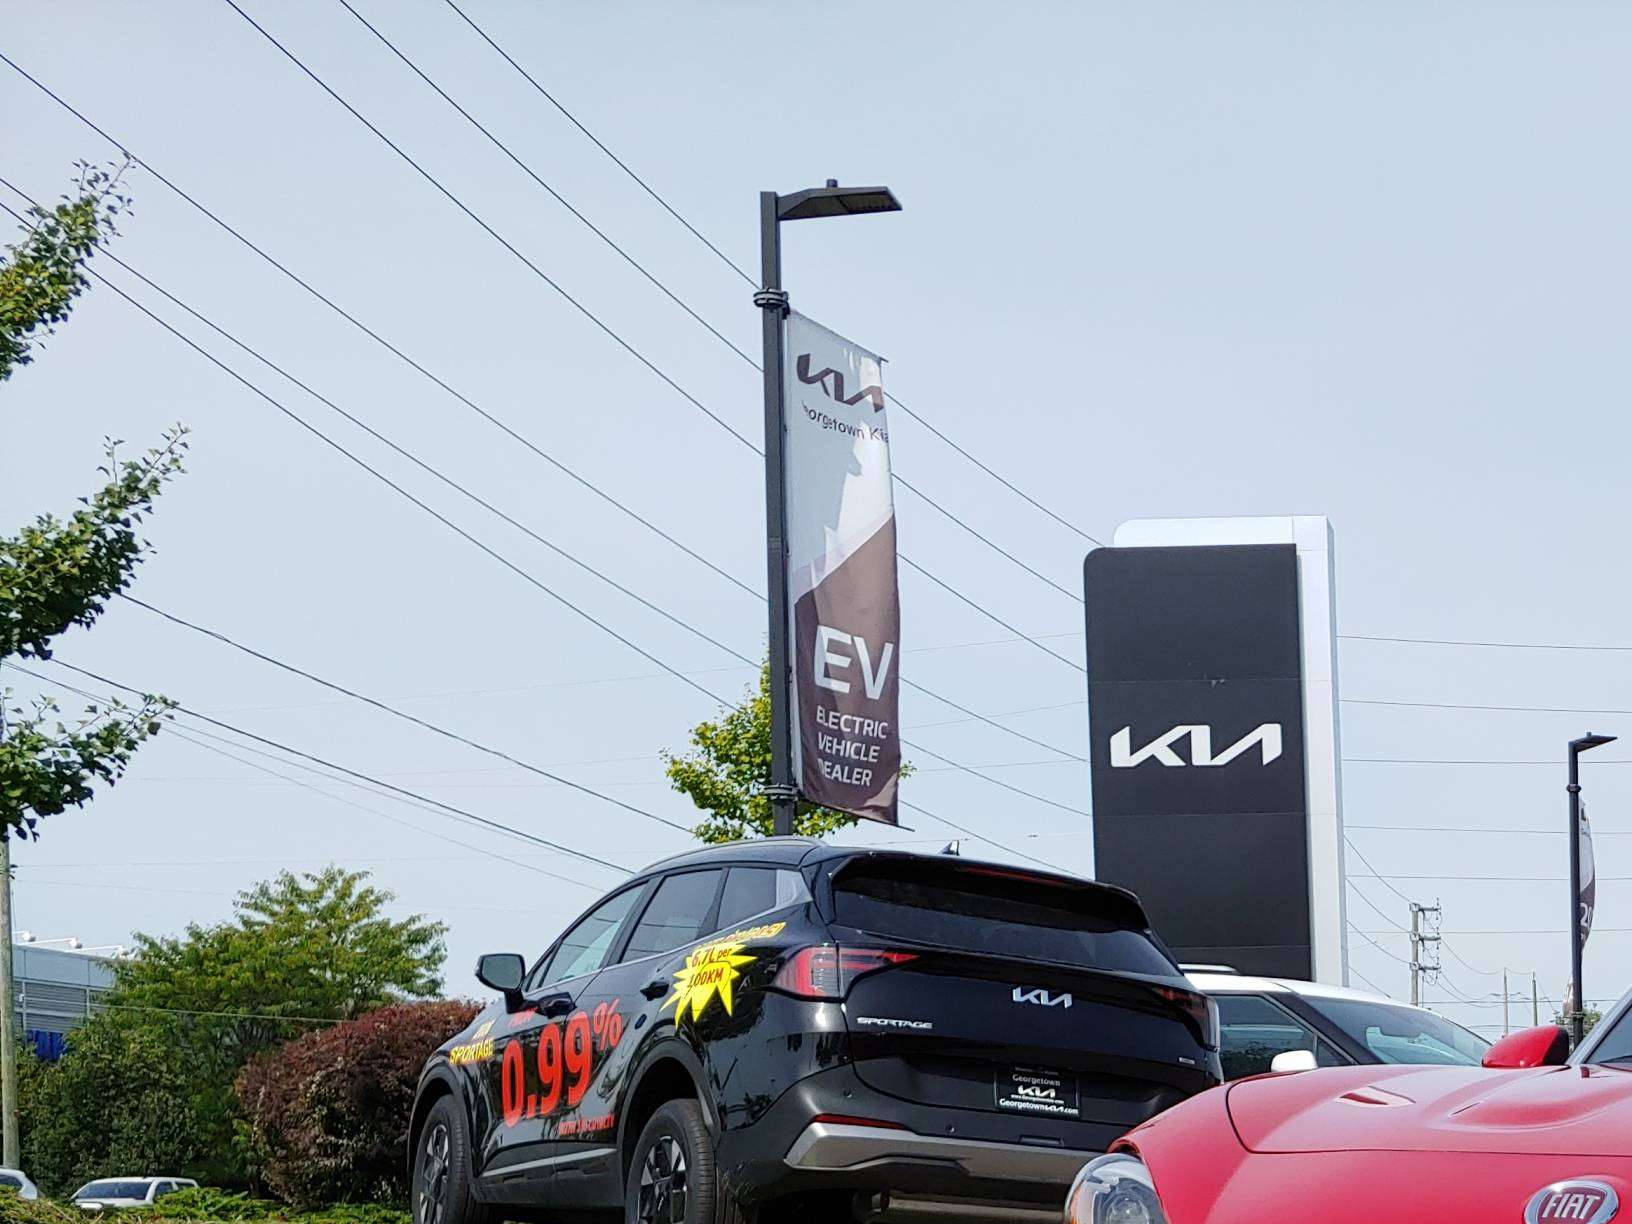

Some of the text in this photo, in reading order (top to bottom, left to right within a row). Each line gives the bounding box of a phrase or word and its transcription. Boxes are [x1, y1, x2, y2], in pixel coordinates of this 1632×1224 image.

[814, 625, 894, 700] EV
[816, 705, 889, 739] ELECTRIC
[817, 731, 881, 763] VEHICLE
[816, 758, 873, 787] DEALER
[717, 948, 732, 960] per
[857, 1016, 933, 1029] SPORTAGE
[450, 1038, 495, 1066] SPORTAGE
[502, 998, 623, 1128] 0.99%
[1013, 1074, 1060, 1087] Georgetown
[1541, 1193, 1601, 1219] FIAT
